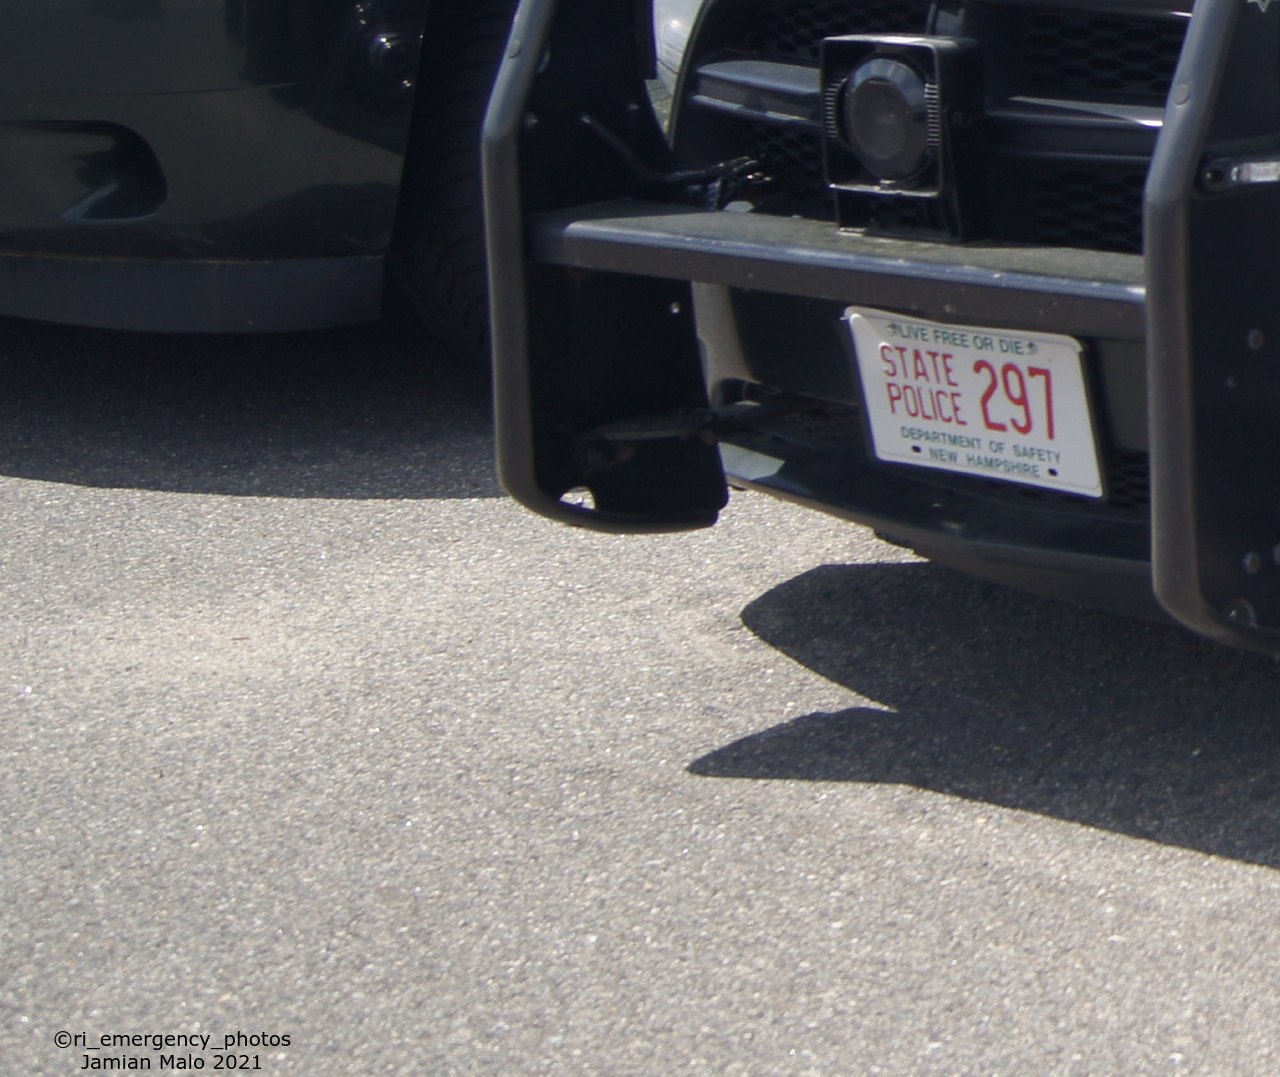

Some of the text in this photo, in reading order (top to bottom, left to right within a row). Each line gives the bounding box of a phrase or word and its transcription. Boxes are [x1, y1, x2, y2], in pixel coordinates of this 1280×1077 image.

[900, 324, 1024, 356] LIVE FREE OR DIE
[880, 345, 959, 387] STATE
[886, 382, 968, 426] POLICE
[973, 359, 1055, 441] 297
[900, 426, 1062, 465] DEPARTMENT OF SAFETY
[929, 448, 1041, 478] NEW HAMPSHIRE
